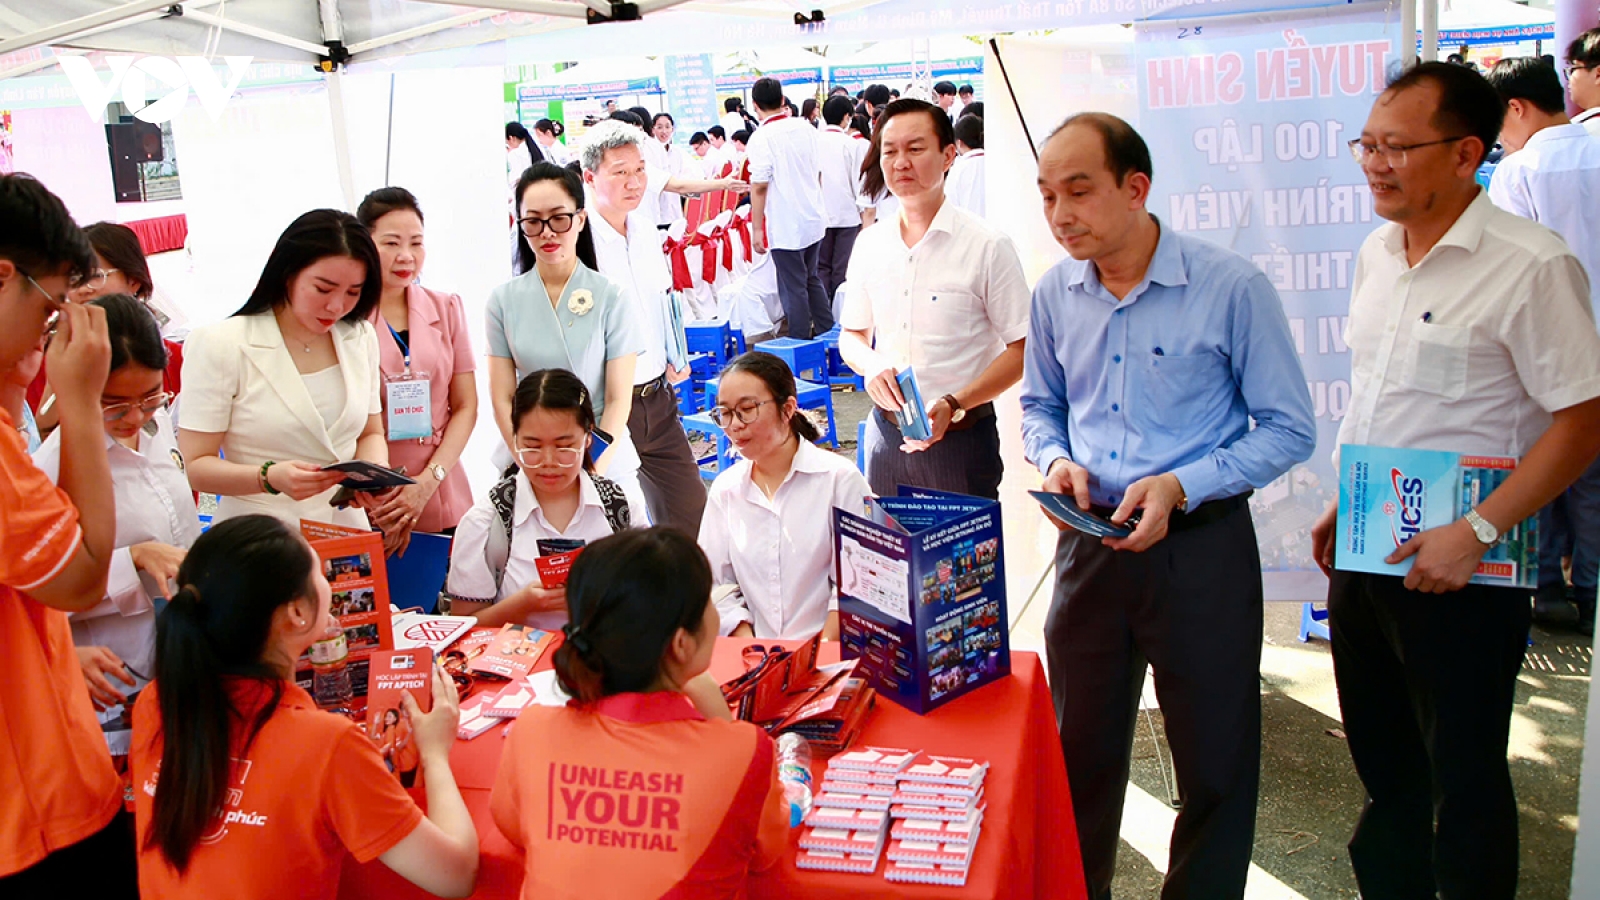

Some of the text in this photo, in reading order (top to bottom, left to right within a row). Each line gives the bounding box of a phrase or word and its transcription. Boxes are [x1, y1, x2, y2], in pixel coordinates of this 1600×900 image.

[394, 680, 424, 689] APTECH
[559, 764, 684, 794] UNLEASH
[224, 809, 268, 826] phúc
[559, 787, 681, 831] YOUR
[556, 824, 678, 852] POTENTIAL
